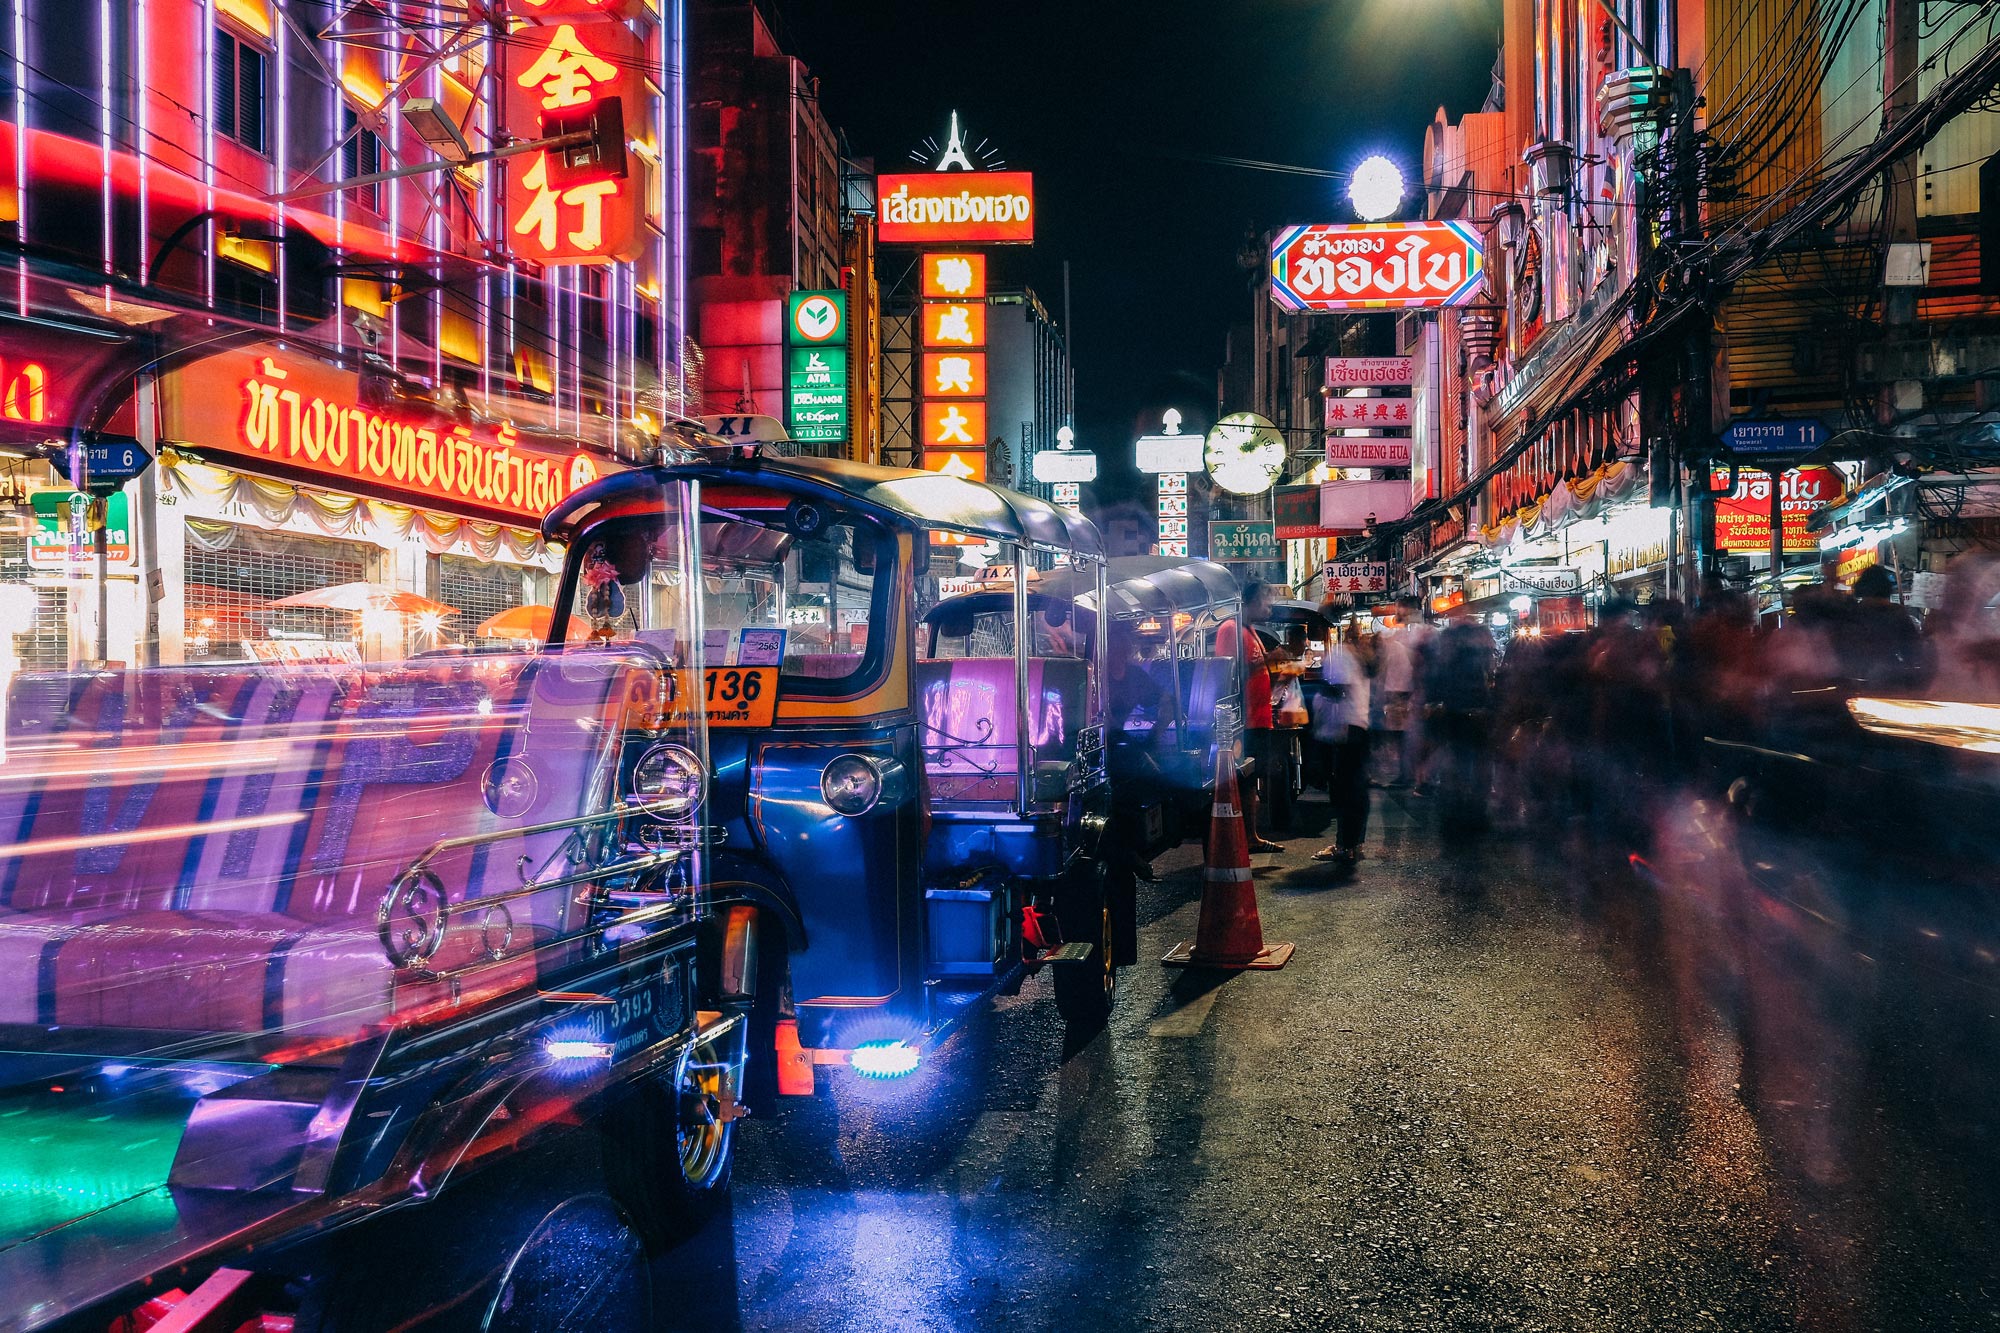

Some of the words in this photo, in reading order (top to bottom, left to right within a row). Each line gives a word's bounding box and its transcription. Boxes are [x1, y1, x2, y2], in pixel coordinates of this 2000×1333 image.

[1303, 234, 1384, 255] ห้างทอง
[1292, 234, 1461, 295] ทองใบ
[806, 373, 831, 384] ATM
[796, 409, 840, 423] K-Expert
[717, 416, 754, 435] XI
[796, 429, 842, 437] WISDOM
[1733, 425, 1785, 438] เยาวราช
[1798, 425, 1815, 443] 11
[122, 449, 133, 467] 6
[1330, 444, 1360, 460] SIANG
[1360, 444, 1387, 460] HENG
[1389, 444, 1409, 460] HUA
[981, 566, 1014, 579] TAX
[758, 641, 779, 651] 2563
[610, 988, 653, 1028] 3393
